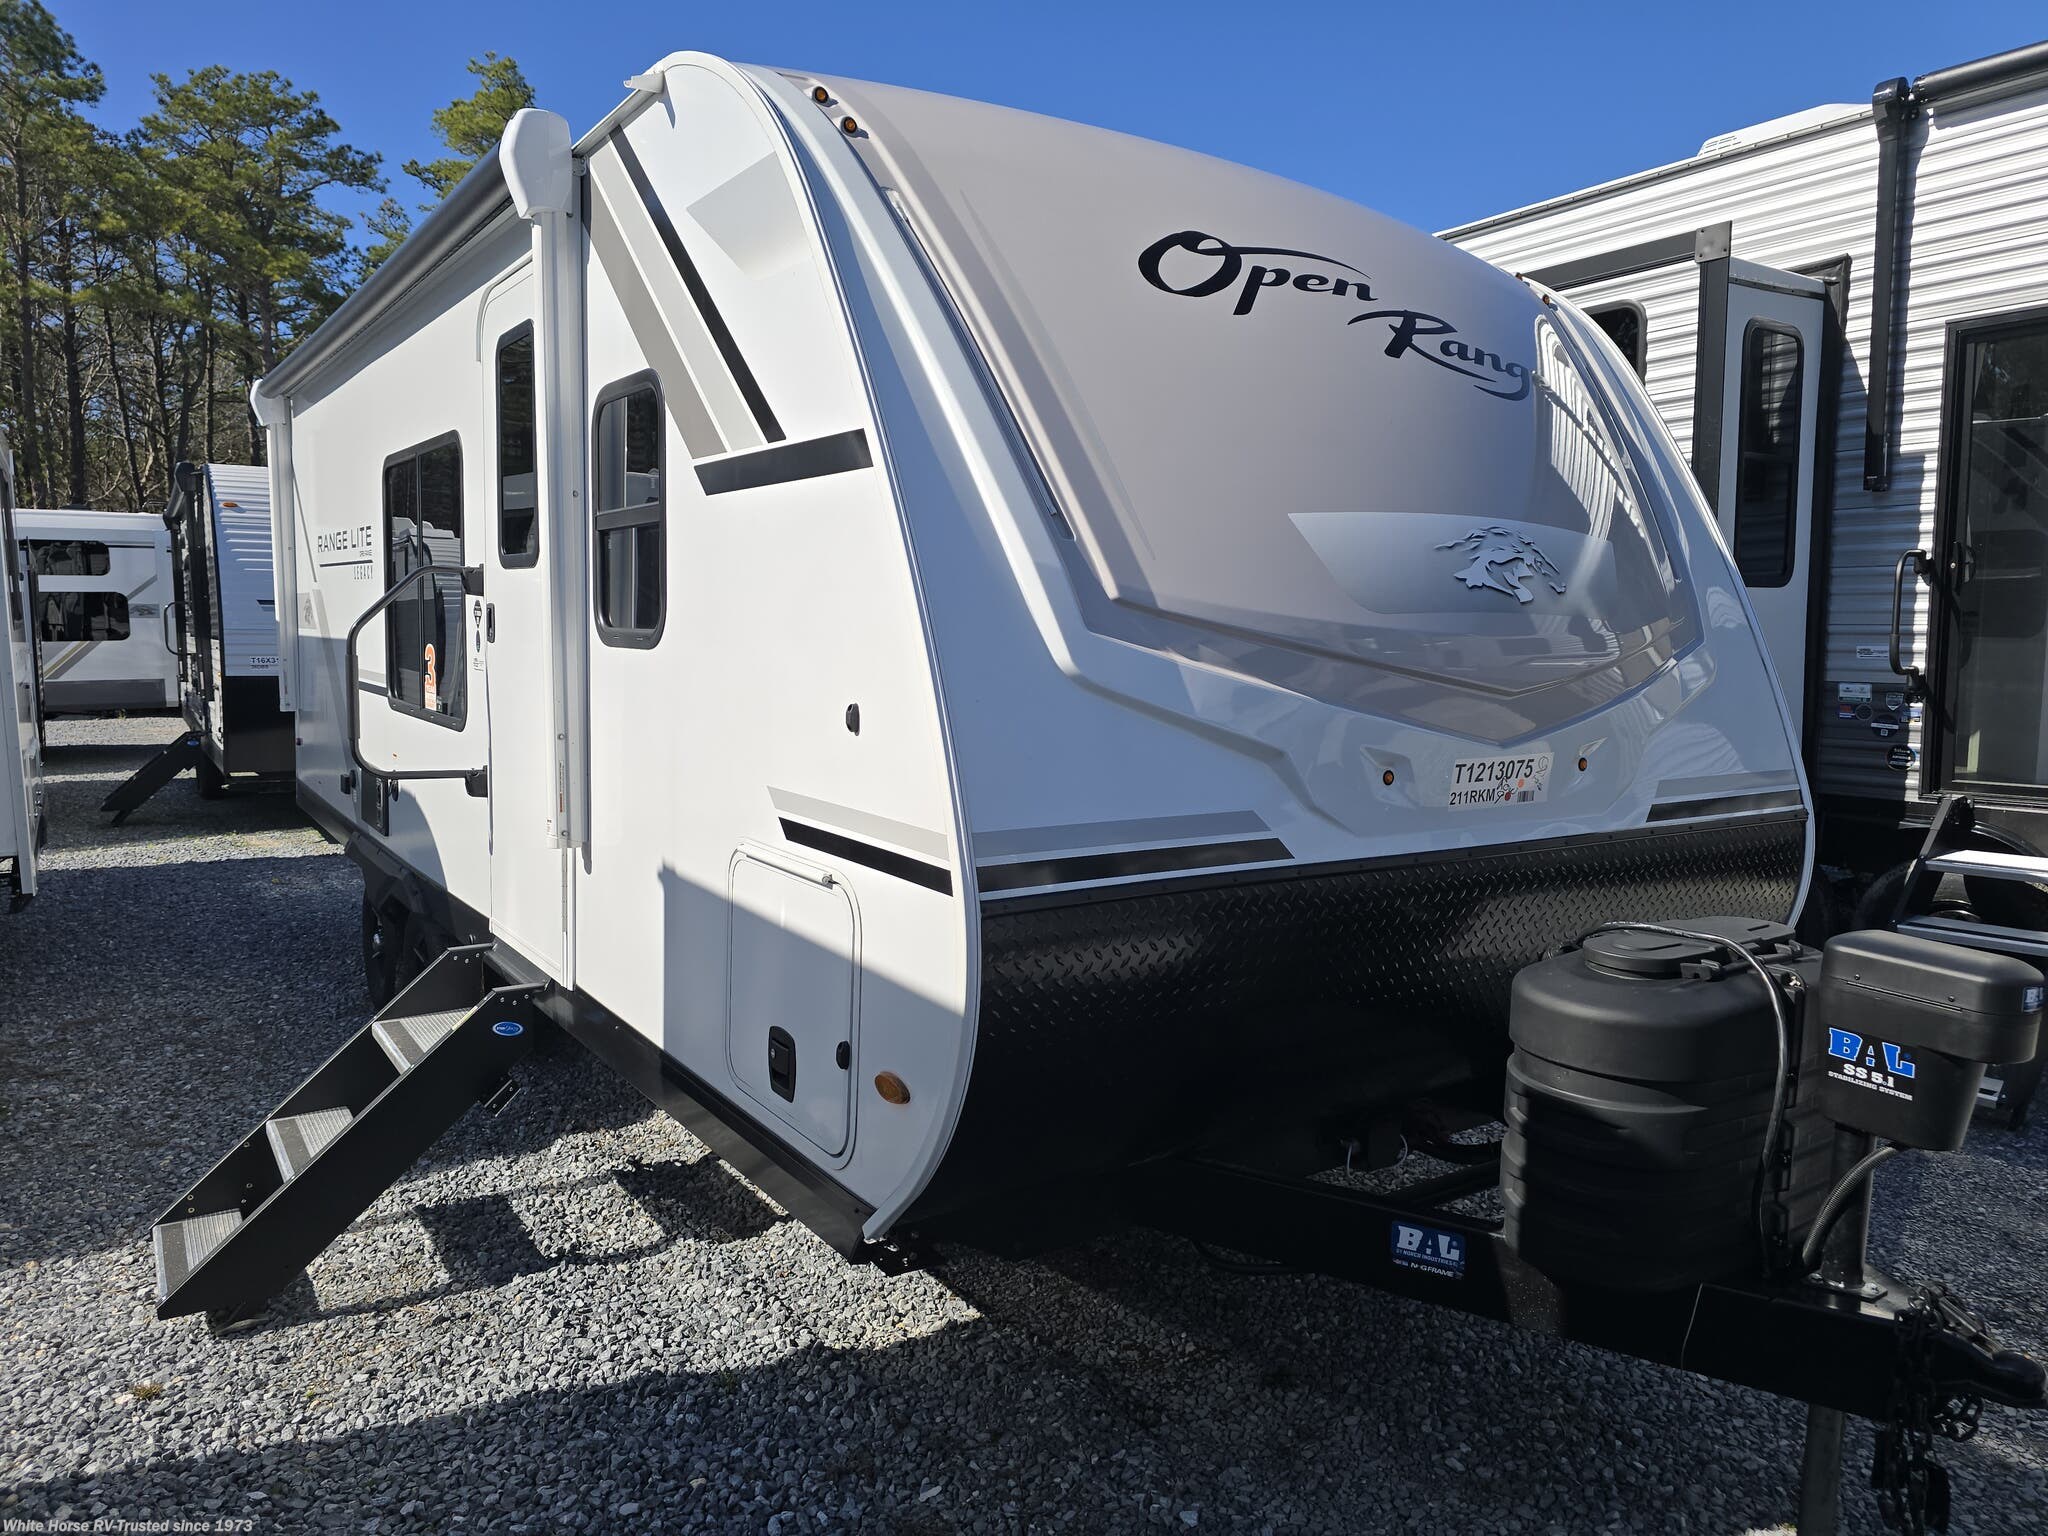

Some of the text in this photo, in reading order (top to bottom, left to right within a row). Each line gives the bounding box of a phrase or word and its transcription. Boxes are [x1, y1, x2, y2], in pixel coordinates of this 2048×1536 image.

[1138, 230, 1378, 316] Open
[1347, 309, 1530, 402] Rang
[318, 525, 372, 553] RANGE LITE
[1455, 759, 1534, 784] T1213075
[1828, 1027, 1916, 1079] BAL
[1828, 1070, 1913, 1101] STABILIZING SYSTEM
[1843, 1063, 1895, 1088] SS 5.1
[1396, 1225, 1460, 1261] BAL
